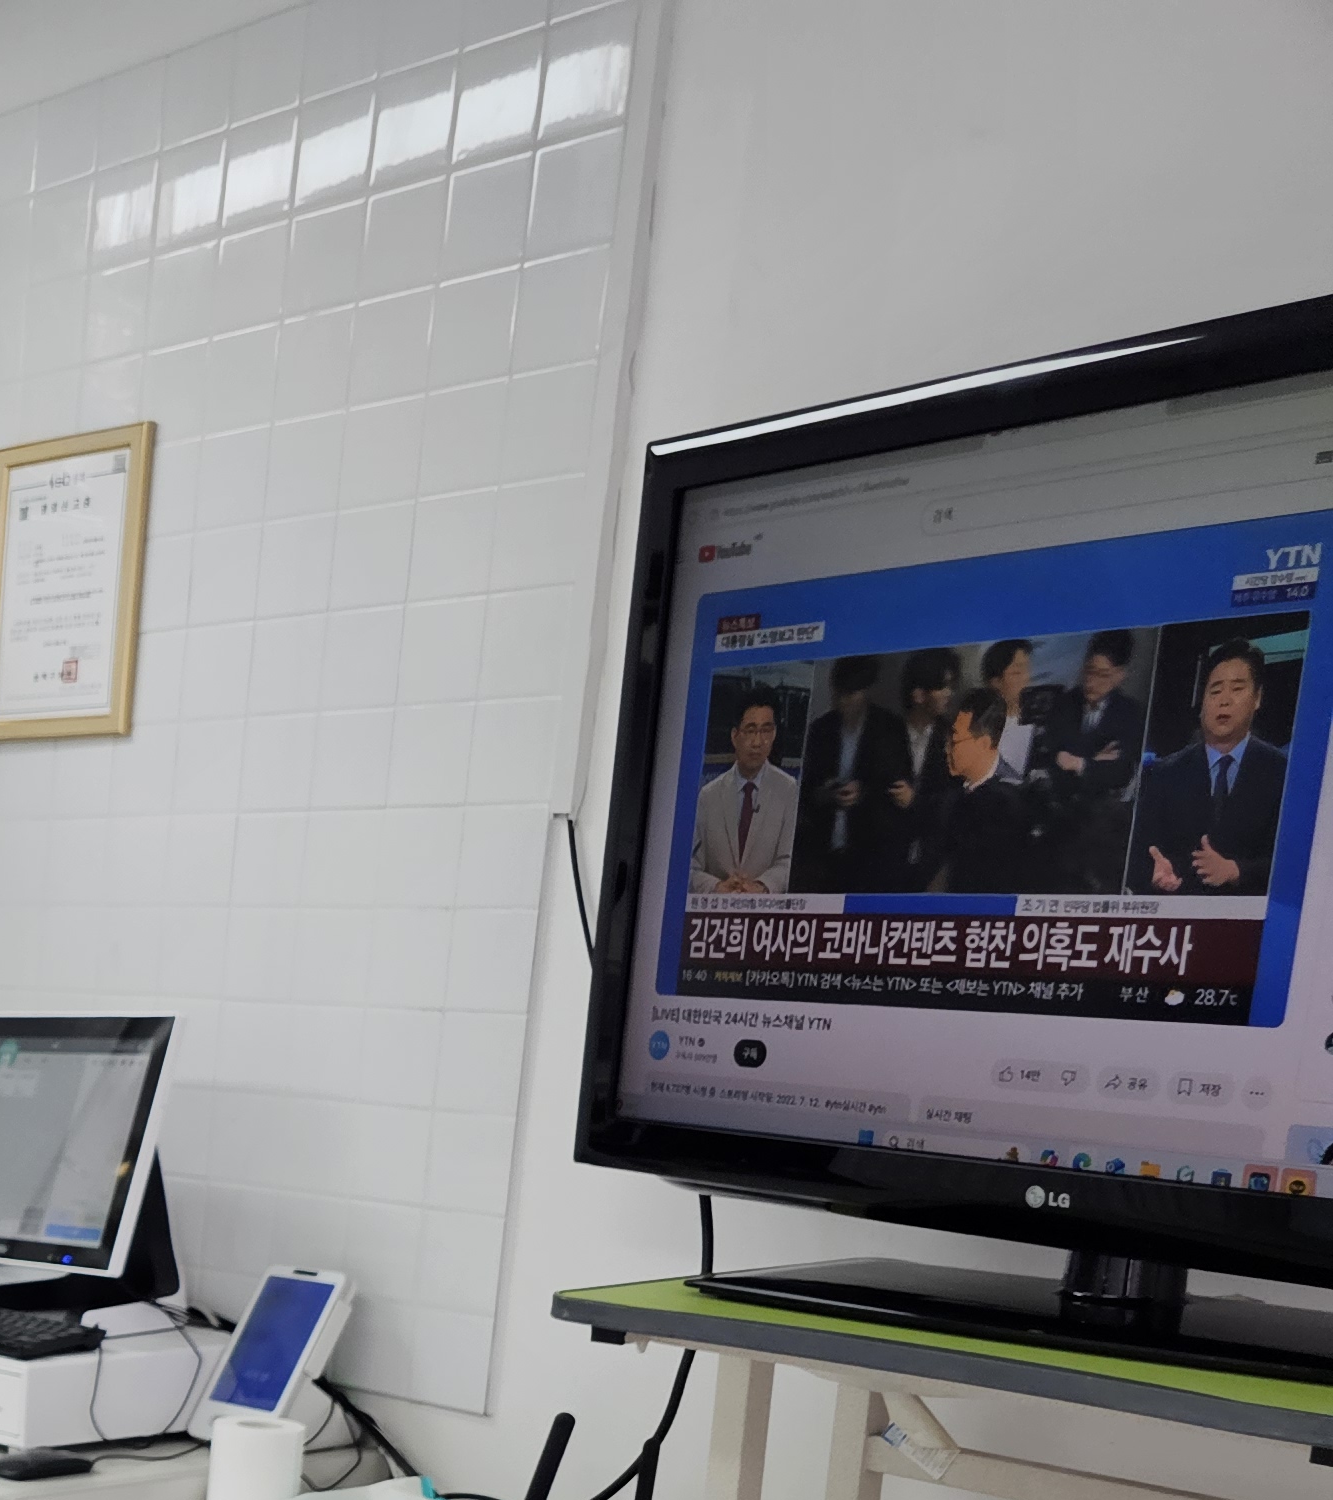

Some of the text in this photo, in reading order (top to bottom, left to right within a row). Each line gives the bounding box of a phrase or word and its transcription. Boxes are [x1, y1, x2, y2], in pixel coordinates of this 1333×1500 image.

[1266, 542, 1323, 570] YTN
[688, 916, 1194, 976] 김건희 여사의 코바나컨텐츠 협찬 의혹도 재수사
[797, 974, 819, 988] YTN
[820, 974, 841, 990] 검색
[843, 974, 884, 992] <뉴스는
[886, 977, 917, 992] YTN>
[918, 976, 944, 994] 또는
[945, 978, 990, 997] <제보는
[992, 981, 1026, 996] YTN>
[1056, 982, 1085, 1002] 추가
[651, 1005, 833, 1032] [LIVE] 대한민국 24시간 뉴스채널 YTN
[679, 1035, 696, 1048] YTN
[1198, 1082, 1223, 1097] 저장
[925, 1107, 952, 1123] 실시간
[1048, 1191, 1071, 1209] LG
